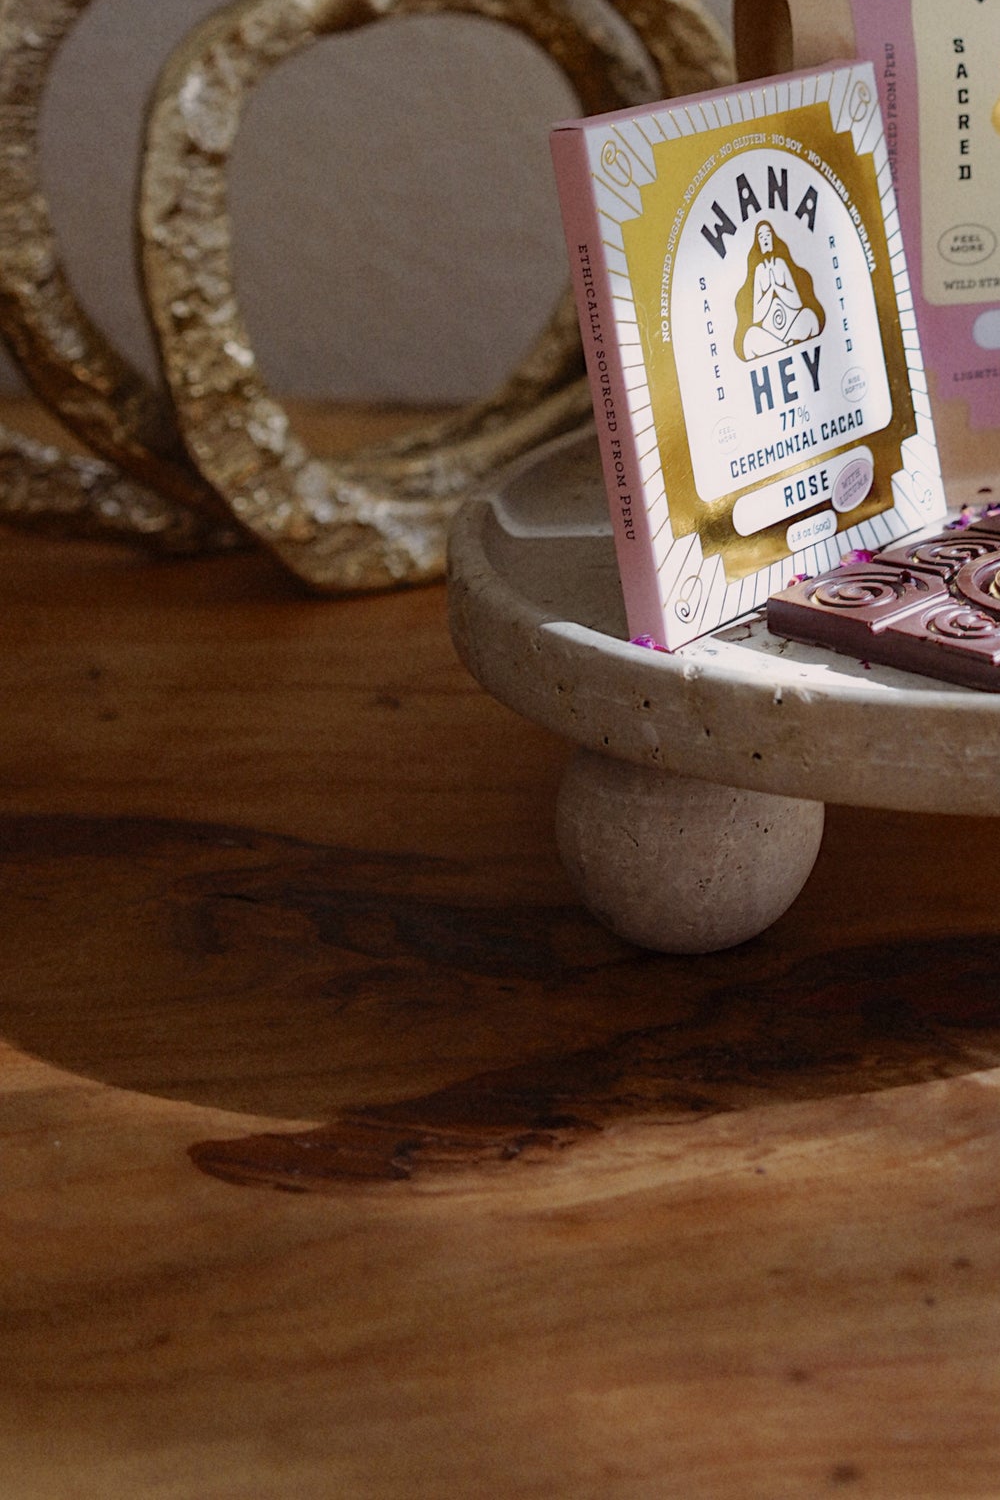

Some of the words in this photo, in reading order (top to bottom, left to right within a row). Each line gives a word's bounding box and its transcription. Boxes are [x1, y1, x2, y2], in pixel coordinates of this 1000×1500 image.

[883, 42, 897, 79] PERU
[886, 81, 898, 119] FROM
[953, 38, 972, 181] SACRED
[719, 143, 733, 158] NO
[732, 132, 767, 150] GLUTEN
[771, 133, 785, 146] NO
[785, 137, 803, 154] SOY
[692, 154, 717, 186] DAIRY
[807, 150, 822, 167] NO
[682, 184, 696, 204] NO
[820, 160, 850, 203] FILLERS
[666, 207, 686, 253] SUGAR
[700, 165, 819, 260] WANA
[849, 204, 862, 226] NO
[857, 223, 877, 274] DRAMA
[950, 243, 985, 253] MORE
[953, 235, 981, 244] FEEL
[660, 254, 673, 318] REFINED
[828, 235, 853, 354] ROOTED
[943, 279, 978, 291] WILD
[661, 320, 671, 343] NO
[699, 276, 725, 402] SACRED
[577, 244, 603, 344] ETHICALLY
[595, 349, 618, 433] SOURCED
[610, 438, 627, 490] FROM
[620, 494, 636, 542] PERU
[749, 345, 822, 416] HEY
[779, 404, 810, 432] 77%
[730, 428, 818, 479] CEREMONIAL
[820, 408, 865, 443] CACAO
[783, 469, 830, 509] ROSE
